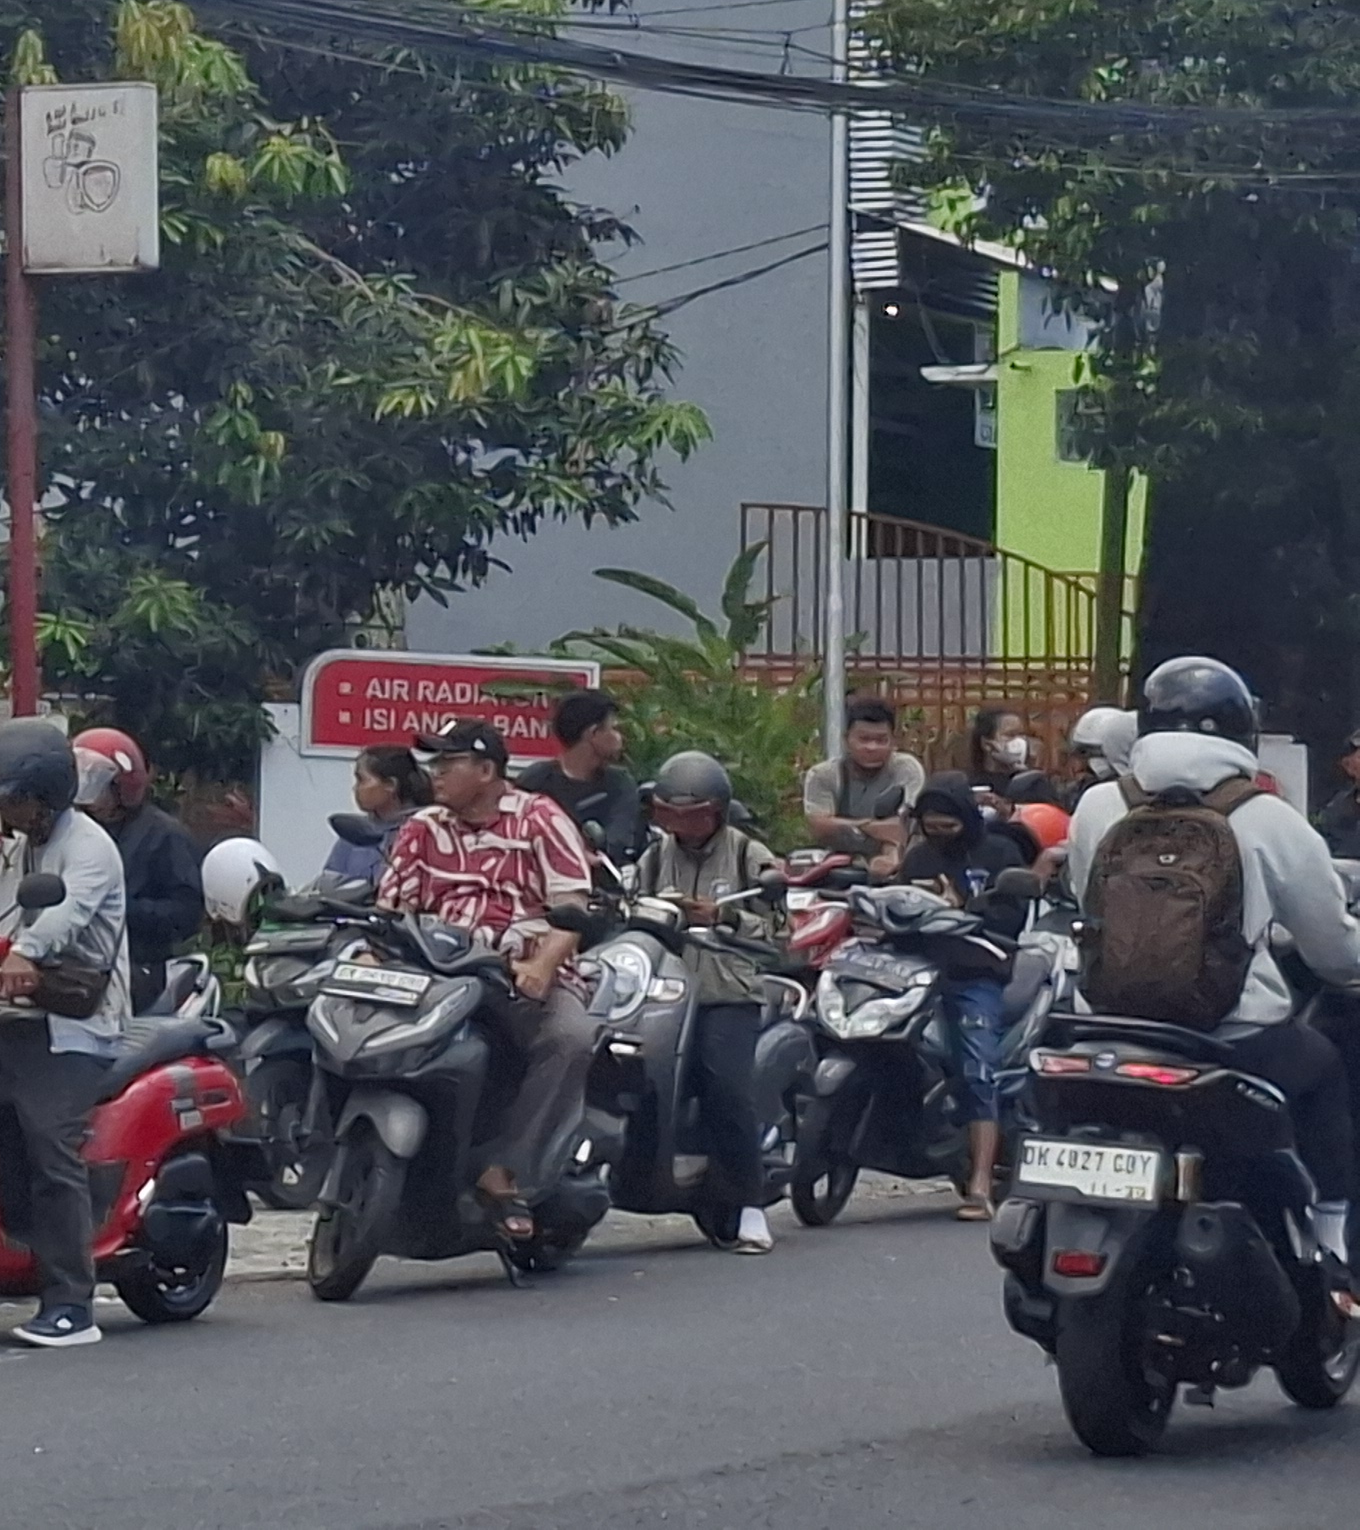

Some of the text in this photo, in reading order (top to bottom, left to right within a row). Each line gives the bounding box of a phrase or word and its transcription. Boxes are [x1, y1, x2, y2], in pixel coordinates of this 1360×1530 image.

[366, 677, 410, 702] AIR
[364, 708, 397, 732] ISI
[493, 714, 549, 740] BAN
